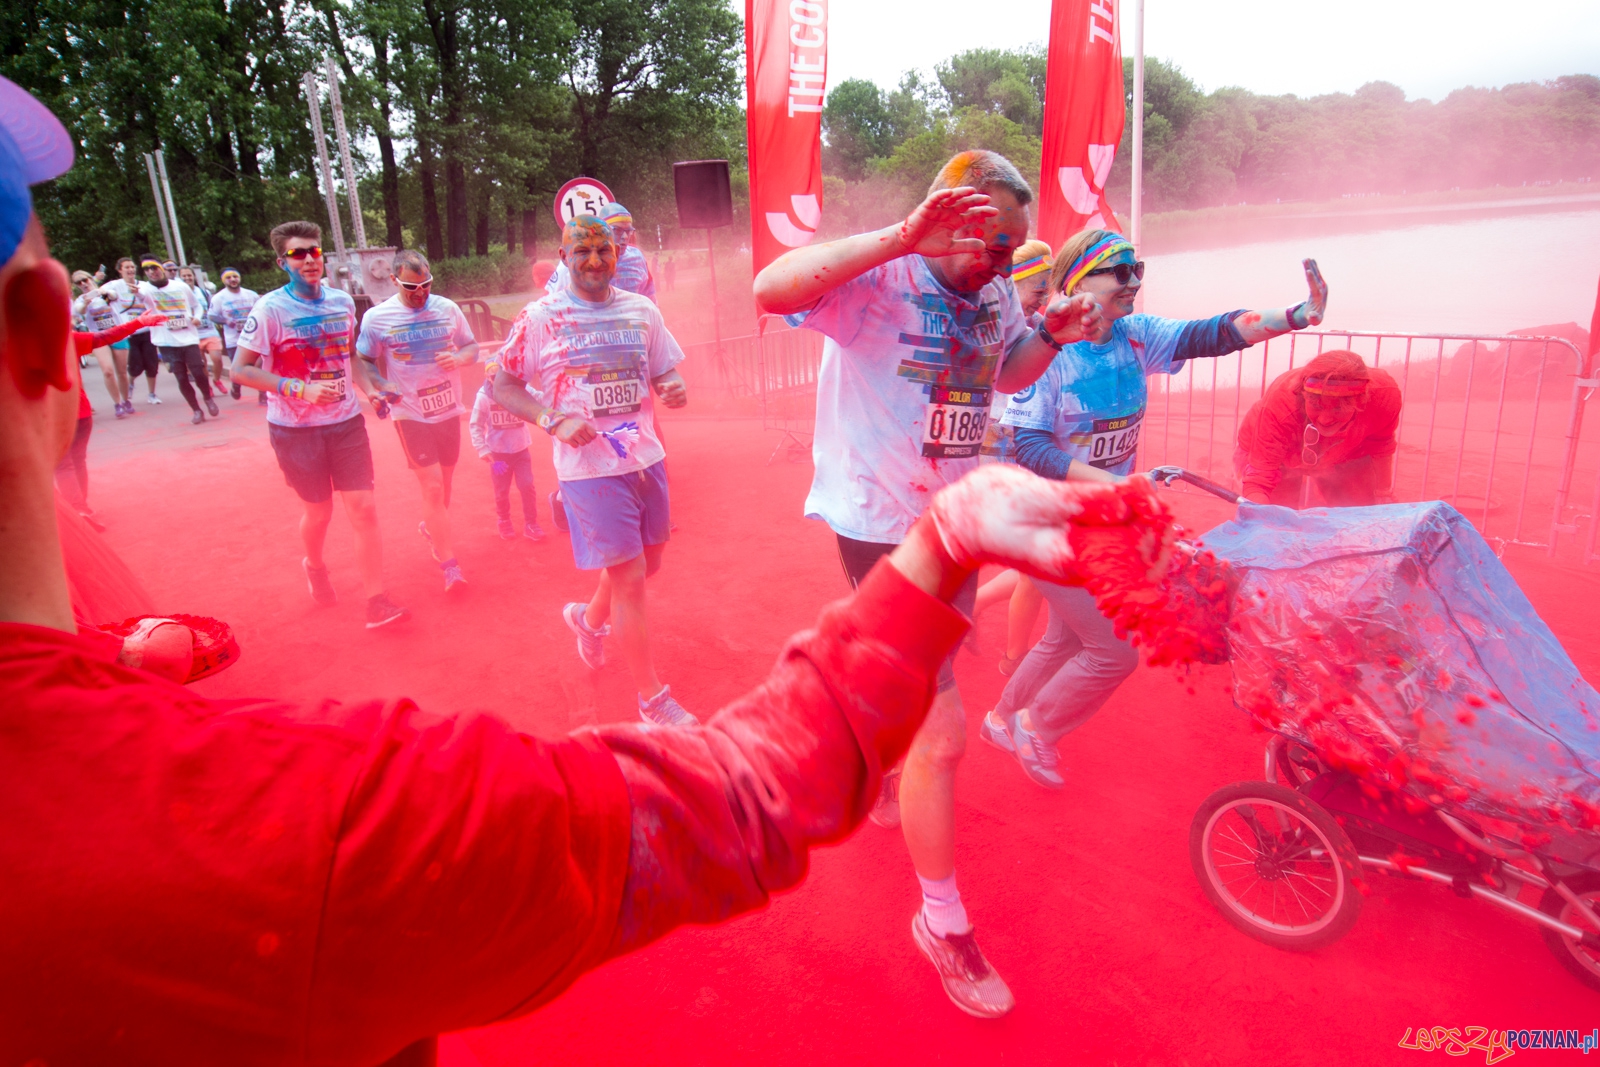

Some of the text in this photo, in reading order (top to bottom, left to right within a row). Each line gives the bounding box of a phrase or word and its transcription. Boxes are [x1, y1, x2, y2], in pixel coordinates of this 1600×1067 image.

[788, 0, 825, 118] THE CO
[922, 311, 947, 335] THE
[393, 326, 448, 343] THE COLOR RUN
[567, 330, 642, 349] THE COLOR RUN
[601, 372, 618, 382] COLOR
[421, 390, 453, 412] 01817
[593, 383, 638, 407] 03857
[948, 391, 971, 403] COLOR
[929, 409, 987, 442] 01889
[1108, 419, 1128, 430] COLOR
[1093, 424, 1141, 459] 01423
